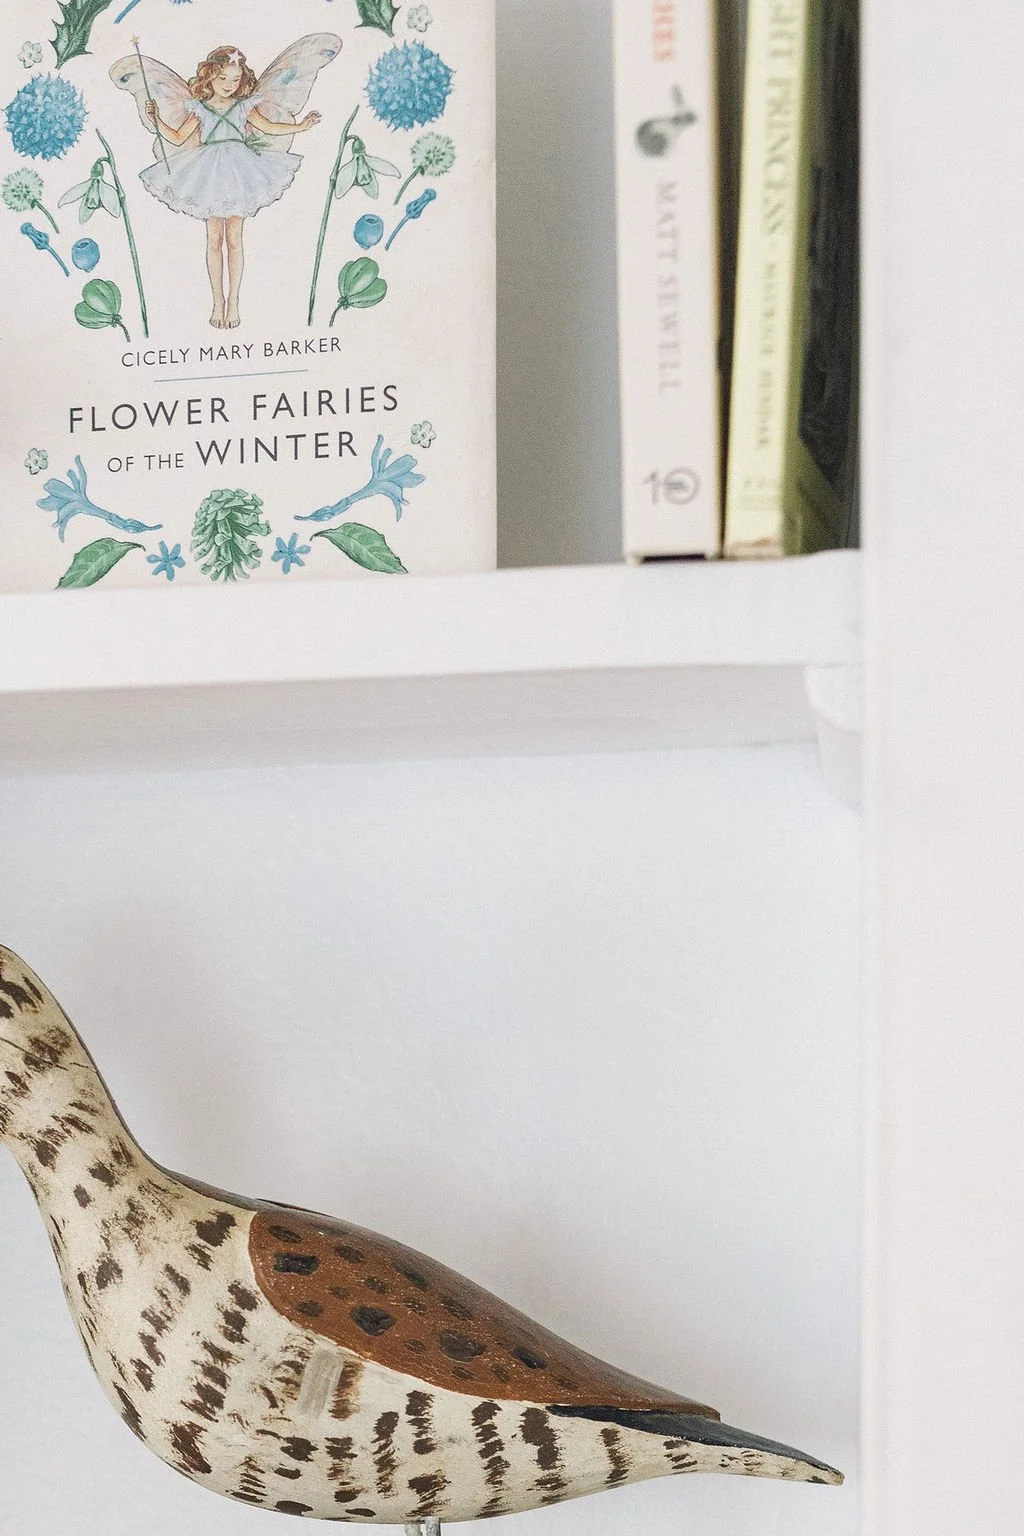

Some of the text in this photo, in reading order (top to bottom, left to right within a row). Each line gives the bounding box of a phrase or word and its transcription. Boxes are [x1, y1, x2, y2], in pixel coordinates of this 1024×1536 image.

[655, 179, 683, 397] MATT SEWELL
[120, 336, 342, 367] CICELY MARY BARKER
[67, 384, 400, 434] FLOWER FAIRIES
[107, 430, 359, 473] OF THE WINTER
